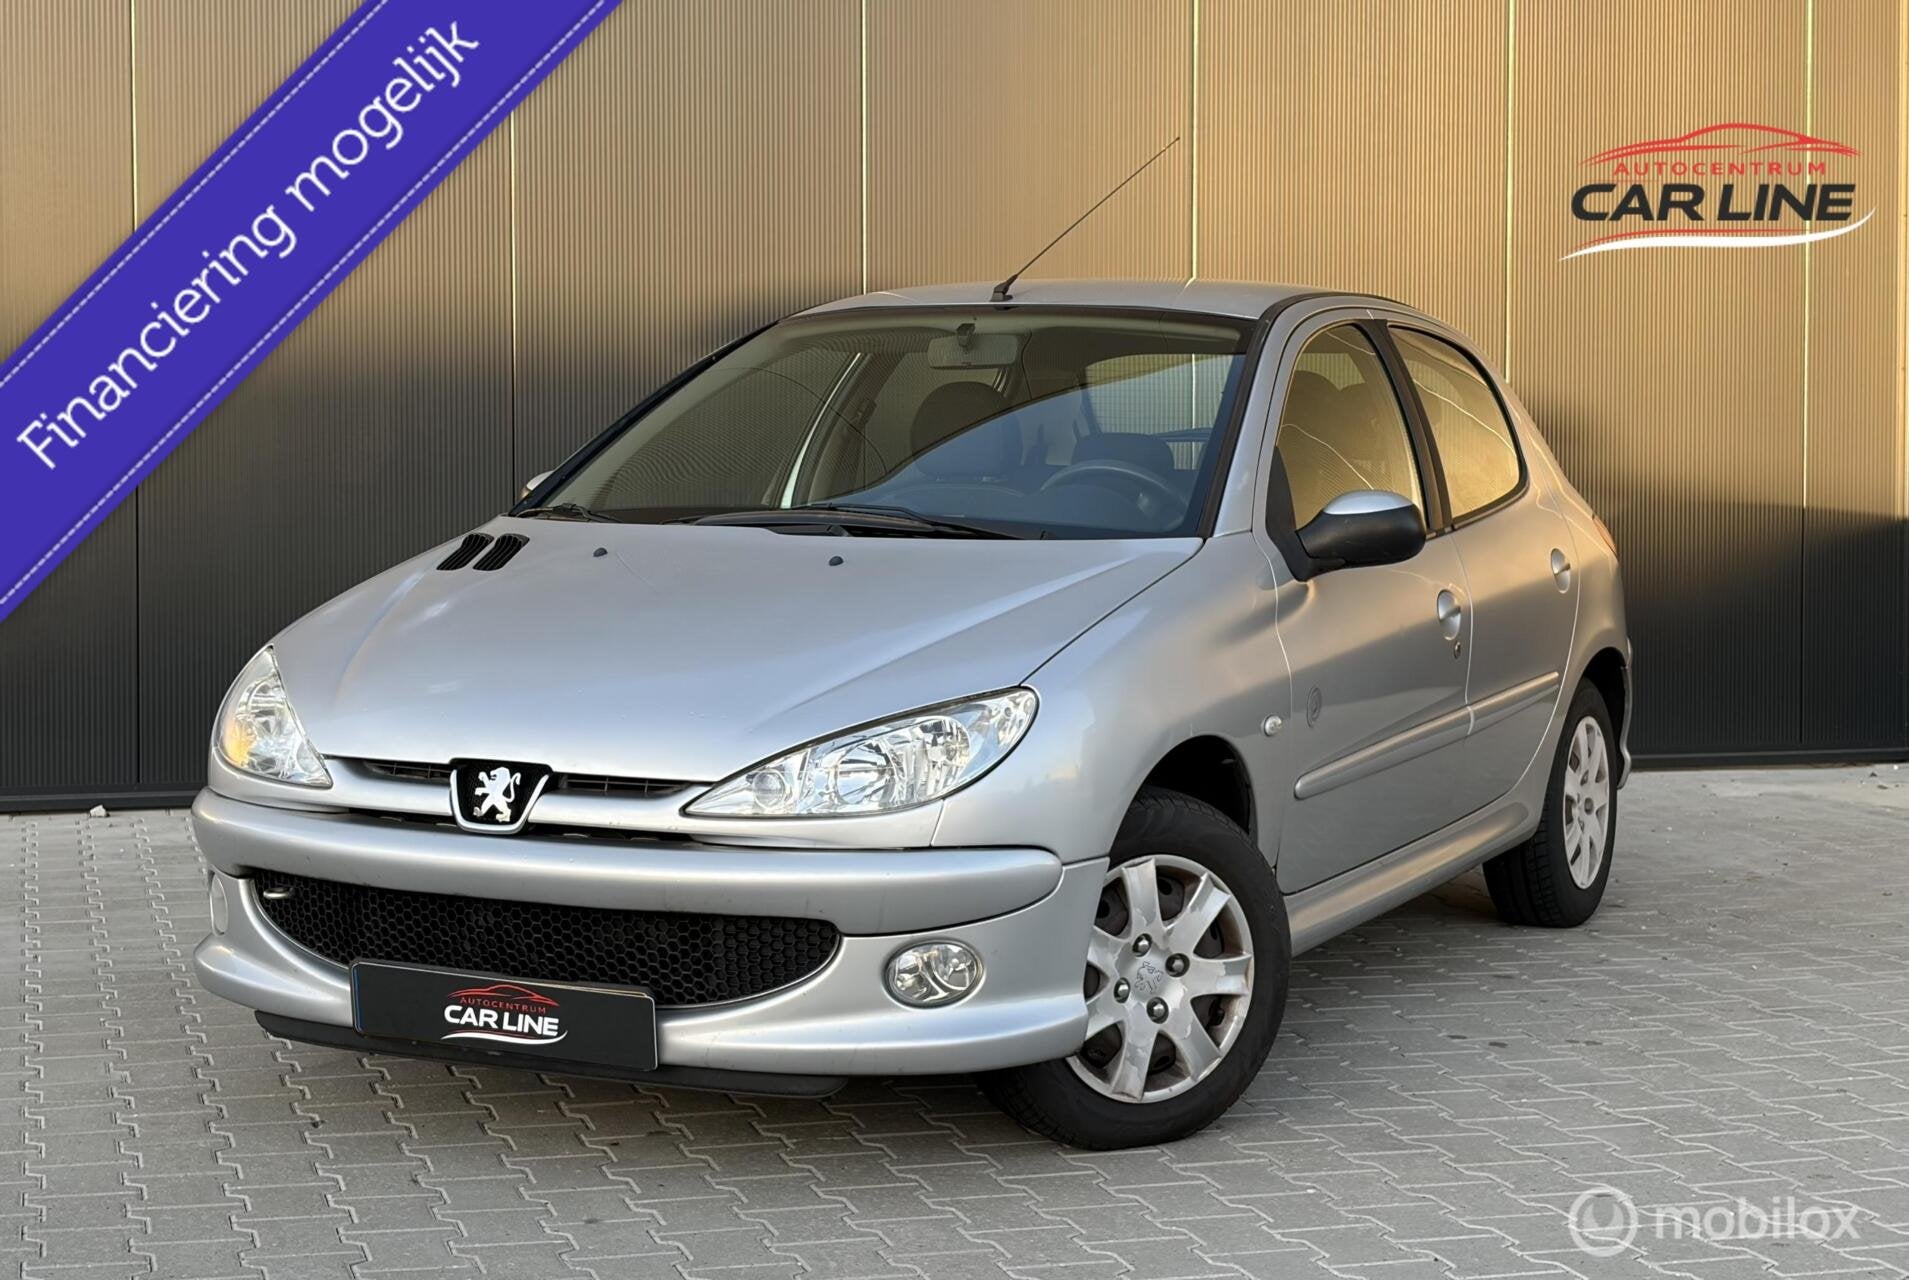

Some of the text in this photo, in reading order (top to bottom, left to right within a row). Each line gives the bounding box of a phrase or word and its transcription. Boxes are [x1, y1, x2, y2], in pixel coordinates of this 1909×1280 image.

[459, 996, 546, 1014] AUTOCENTRUM
[443, 1004, 560, 1037] CAR LINE
